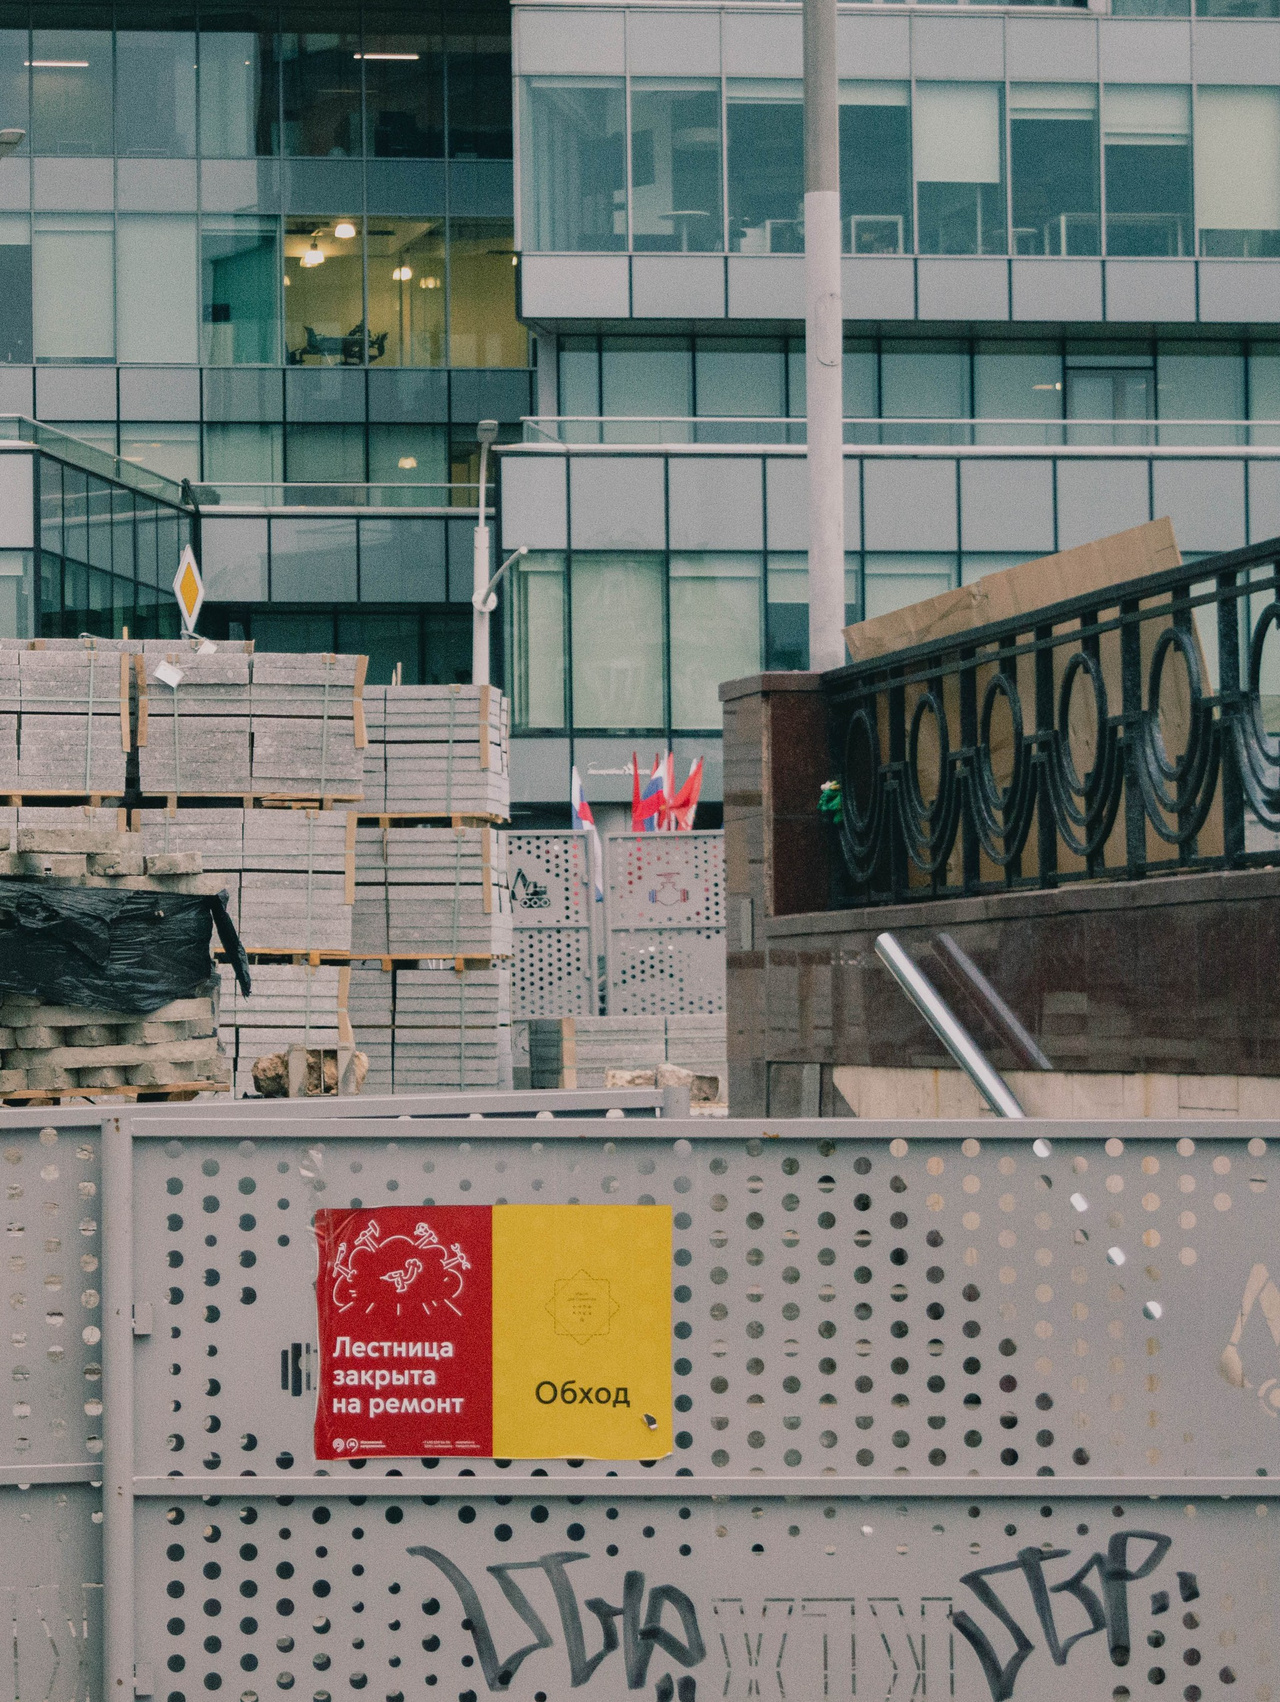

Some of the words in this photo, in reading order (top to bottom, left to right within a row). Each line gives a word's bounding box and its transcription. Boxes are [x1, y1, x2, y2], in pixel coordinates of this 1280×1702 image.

[332, 1336, 453, 1360] Лестница
[332, 1369, 436, 1390] закрыта
[536, 1380, 631, 1407] Обход
[332, 1397, 361, 1414] на
[368, 1397, 464, 1418] ремонт
